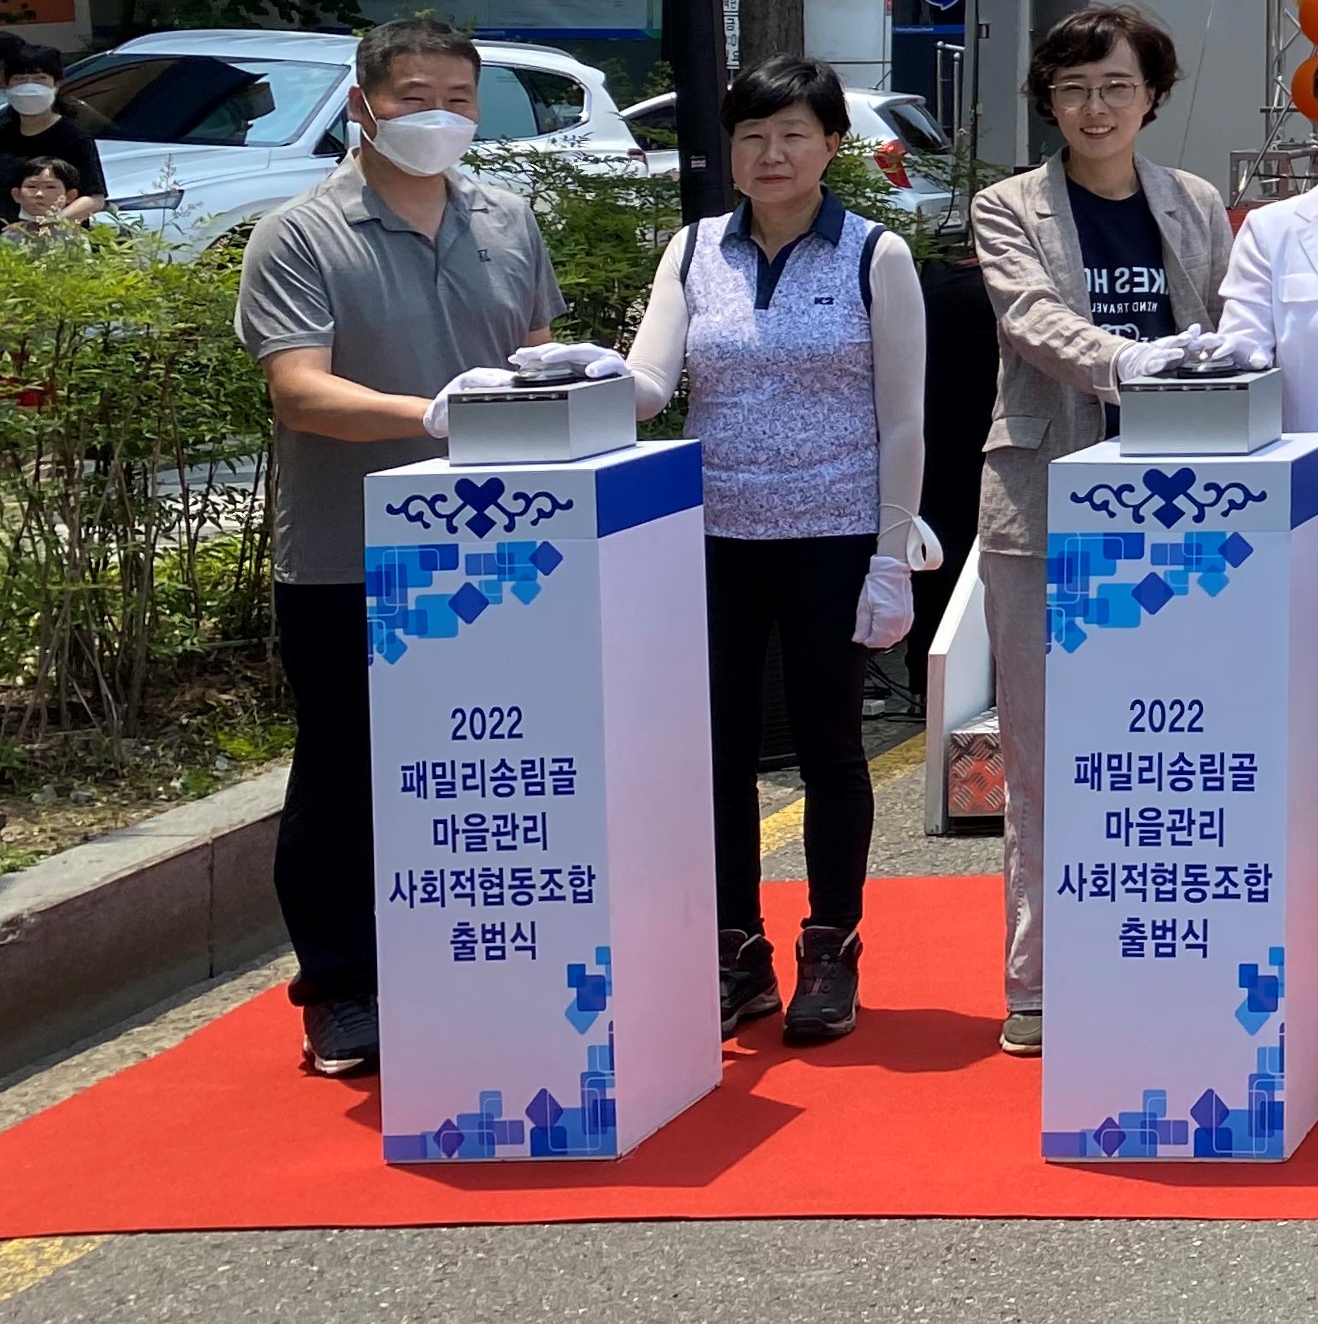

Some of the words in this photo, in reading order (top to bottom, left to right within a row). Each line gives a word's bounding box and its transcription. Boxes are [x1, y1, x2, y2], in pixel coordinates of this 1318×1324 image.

[450, 706, 524, 741] 2022
[1128, 698, 1204, 733] 2022
[400, 757, 577, 800] 패밀리송림골
[1074, 751, 1258, 793] 패밀리송림골
[432, 811, 548, 854] 마을관리
[1105, 807, 1224, 848] 마을관리
[389, 864, 596, 909] 사회적협동조합
[1056, 862, 1273, 904] 사회적협동조합
[449, 920, 537, 962] 출범식
[1118, 917, 1208, 959] 출범식
